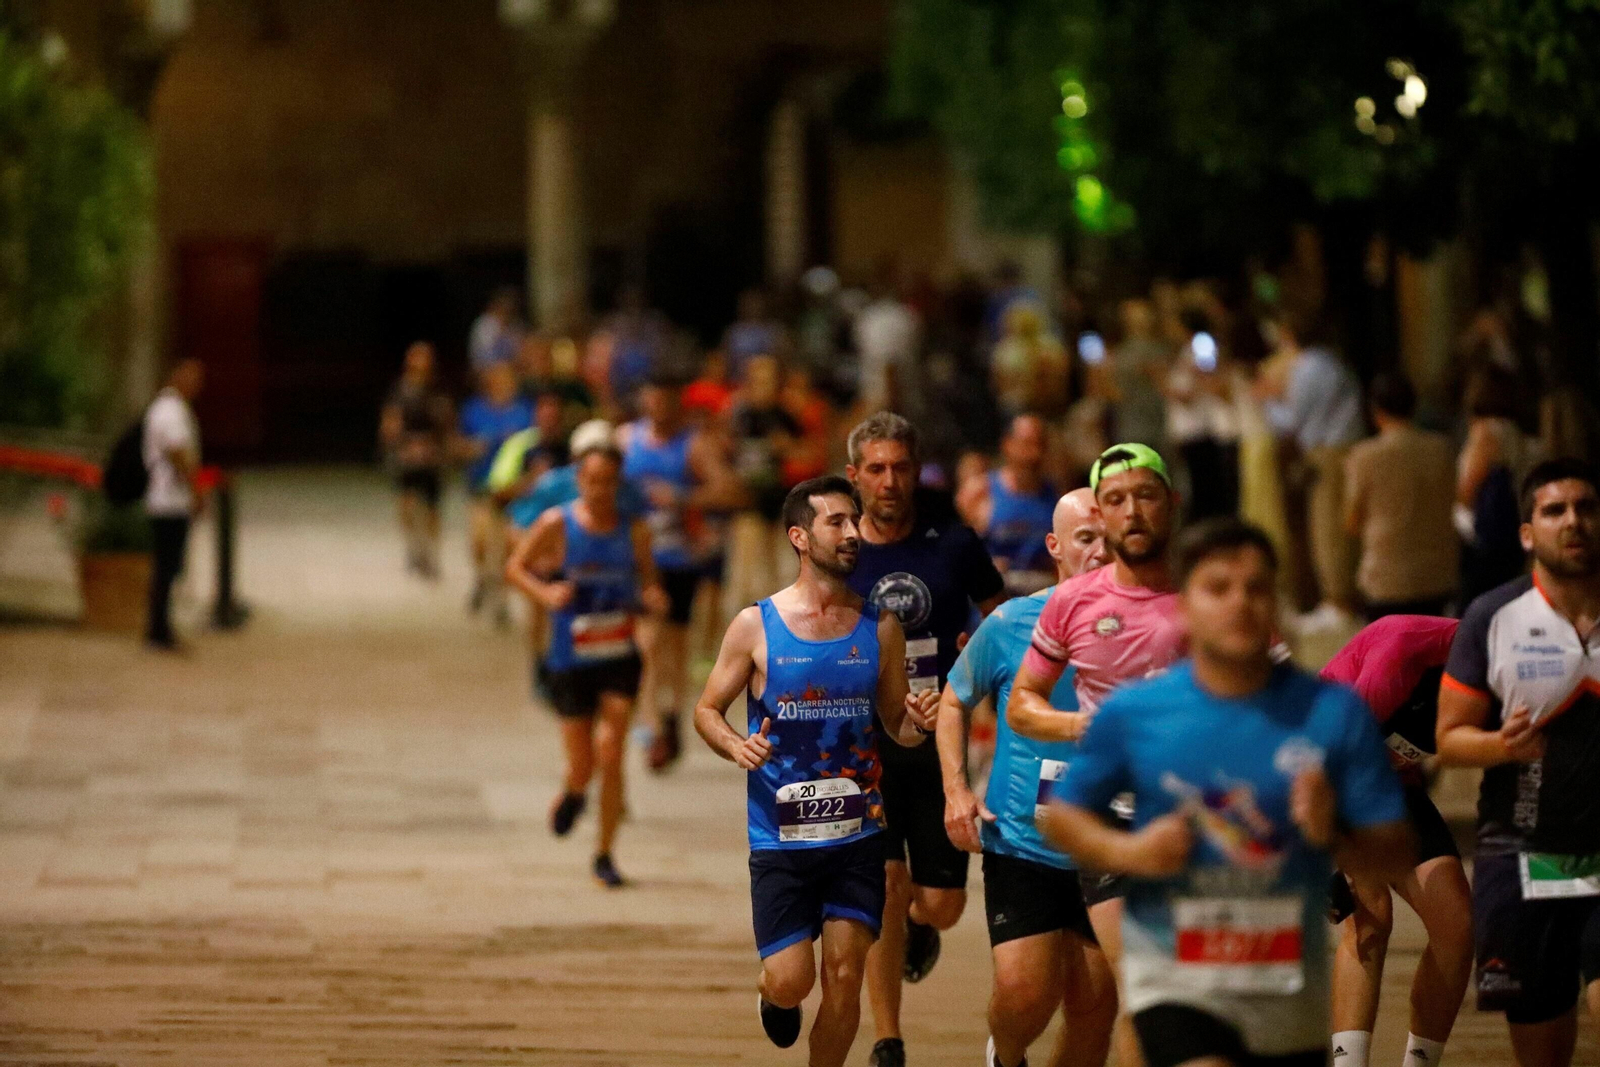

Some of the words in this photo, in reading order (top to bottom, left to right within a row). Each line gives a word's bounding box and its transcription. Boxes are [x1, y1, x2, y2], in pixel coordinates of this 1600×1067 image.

[777, 701, 798, 720] 20
[797, 699, 832, 708] CARRERA
[833, 697, 870, 706] NOCTURNA
[798, 705, 870, 720] TROTACALLES
[1402, 747, 1421, 760] 20
[800, 785, 816, 798] 20
[796, 797, 845, 819] 1222
